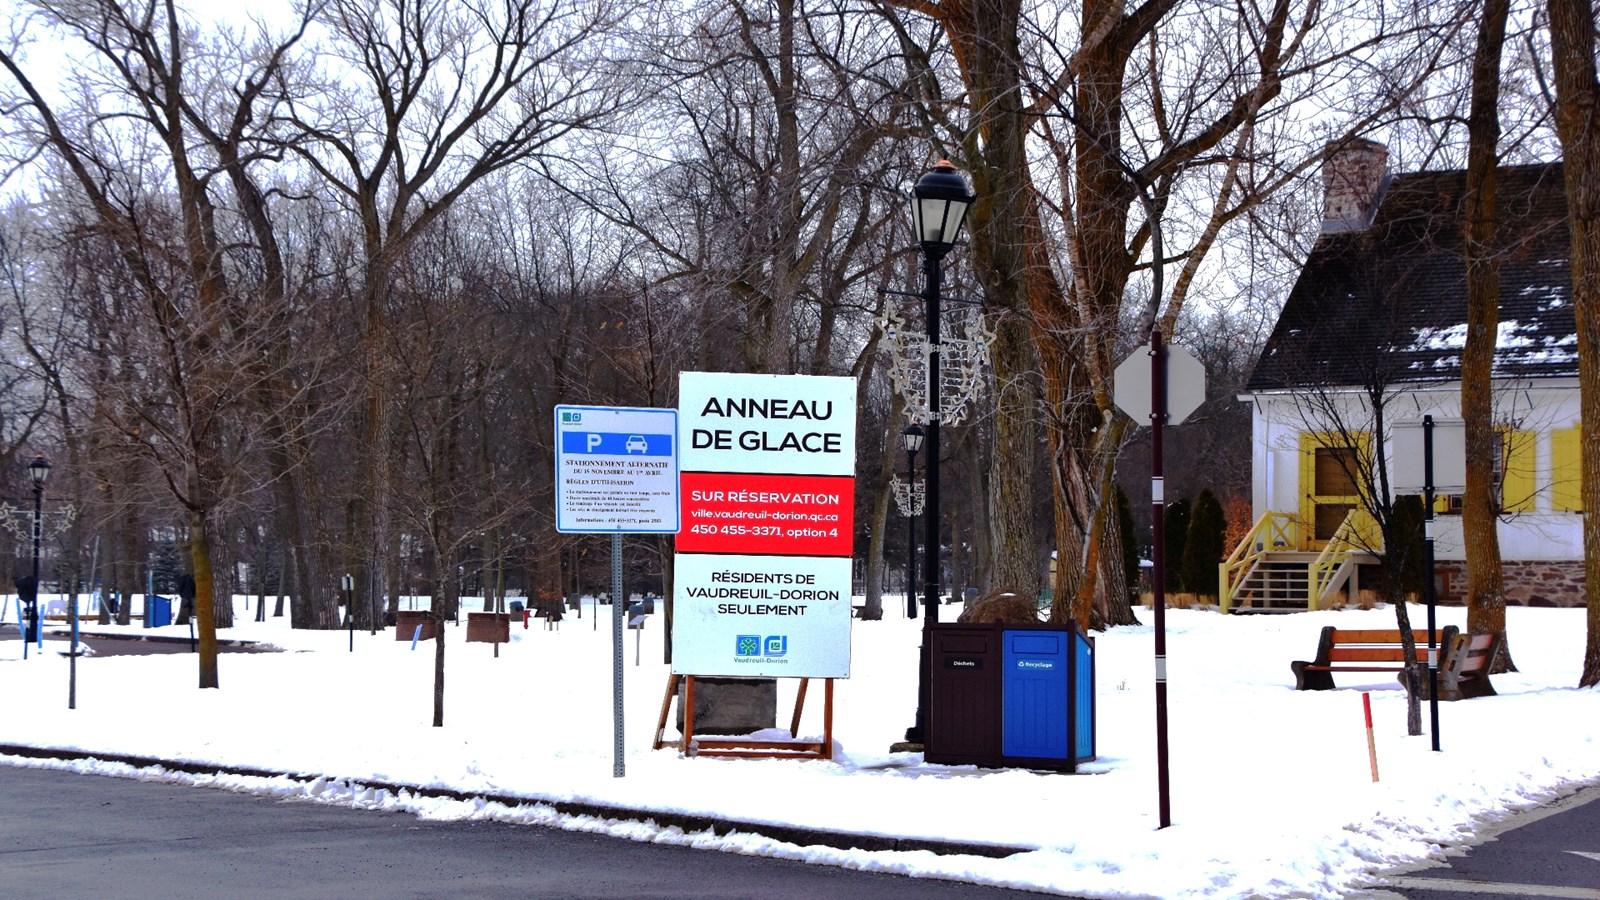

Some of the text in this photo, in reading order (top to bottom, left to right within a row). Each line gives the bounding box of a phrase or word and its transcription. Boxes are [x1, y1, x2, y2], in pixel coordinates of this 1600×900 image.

[701, 397, 832, 420] ANNEAU
[587, 433, 602, 453] P
[692, 429, 841, 453] DE GLACE
[565, 459, 625, 467] STATIONNEMENT
[691, 489, 839, 505] SUR RÉSERVATION
[691, 509, 838, 522] ville.vaudreuil-dorion.qc.ca
[691, 525, 838, 539] 450 455-3371, option 4
[711, 570, 815, 585] RÉSIDENTS DE
[686, 587, 839, 601] VAUDREUIL-DORION
[718, 604, 807, 616] SEULEMENT
